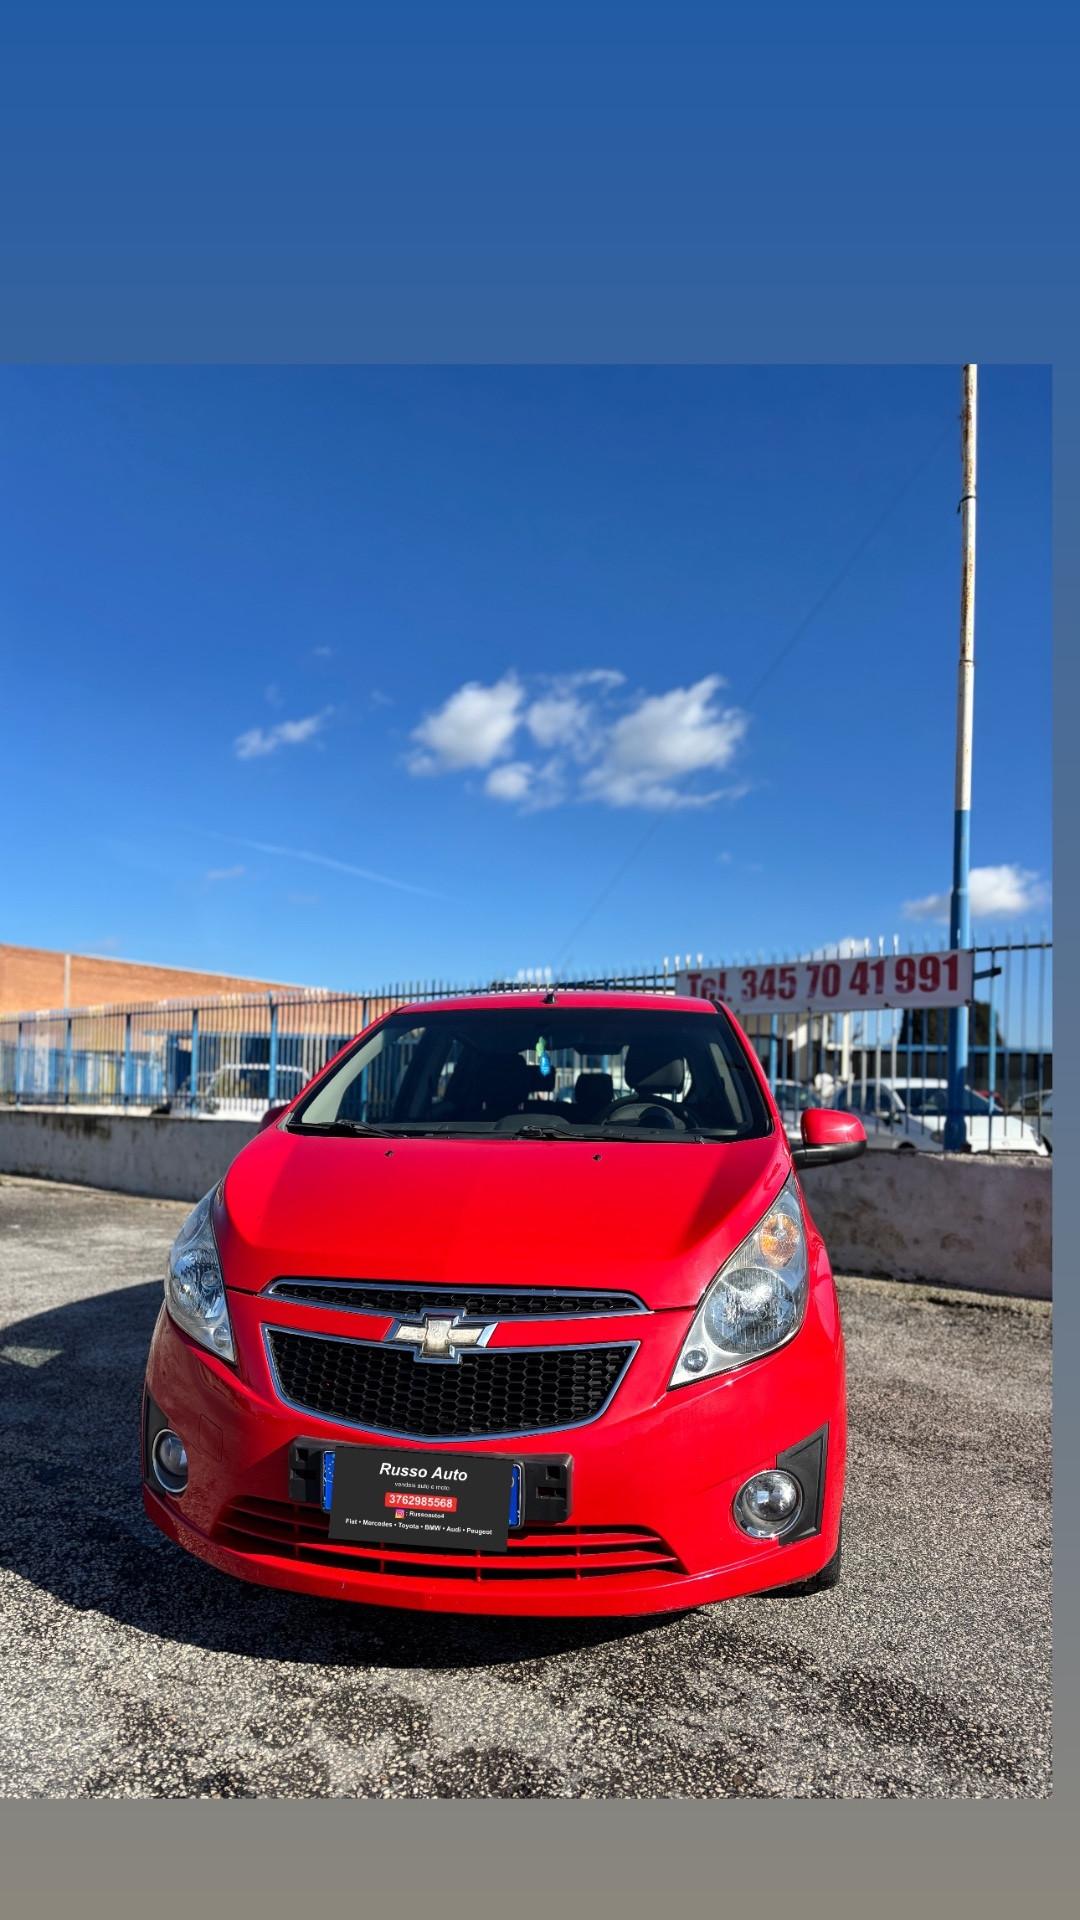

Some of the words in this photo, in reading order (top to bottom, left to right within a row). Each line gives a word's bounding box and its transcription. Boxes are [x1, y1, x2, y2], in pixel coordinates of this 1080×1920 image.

[686, 972, 732, 1003] Tel.
[741, 966, 797, 1002] 345
[806, 963, 841, 998] 70
[849, 959, 886, 995] 41
[894, 954, 959, 994] 991
